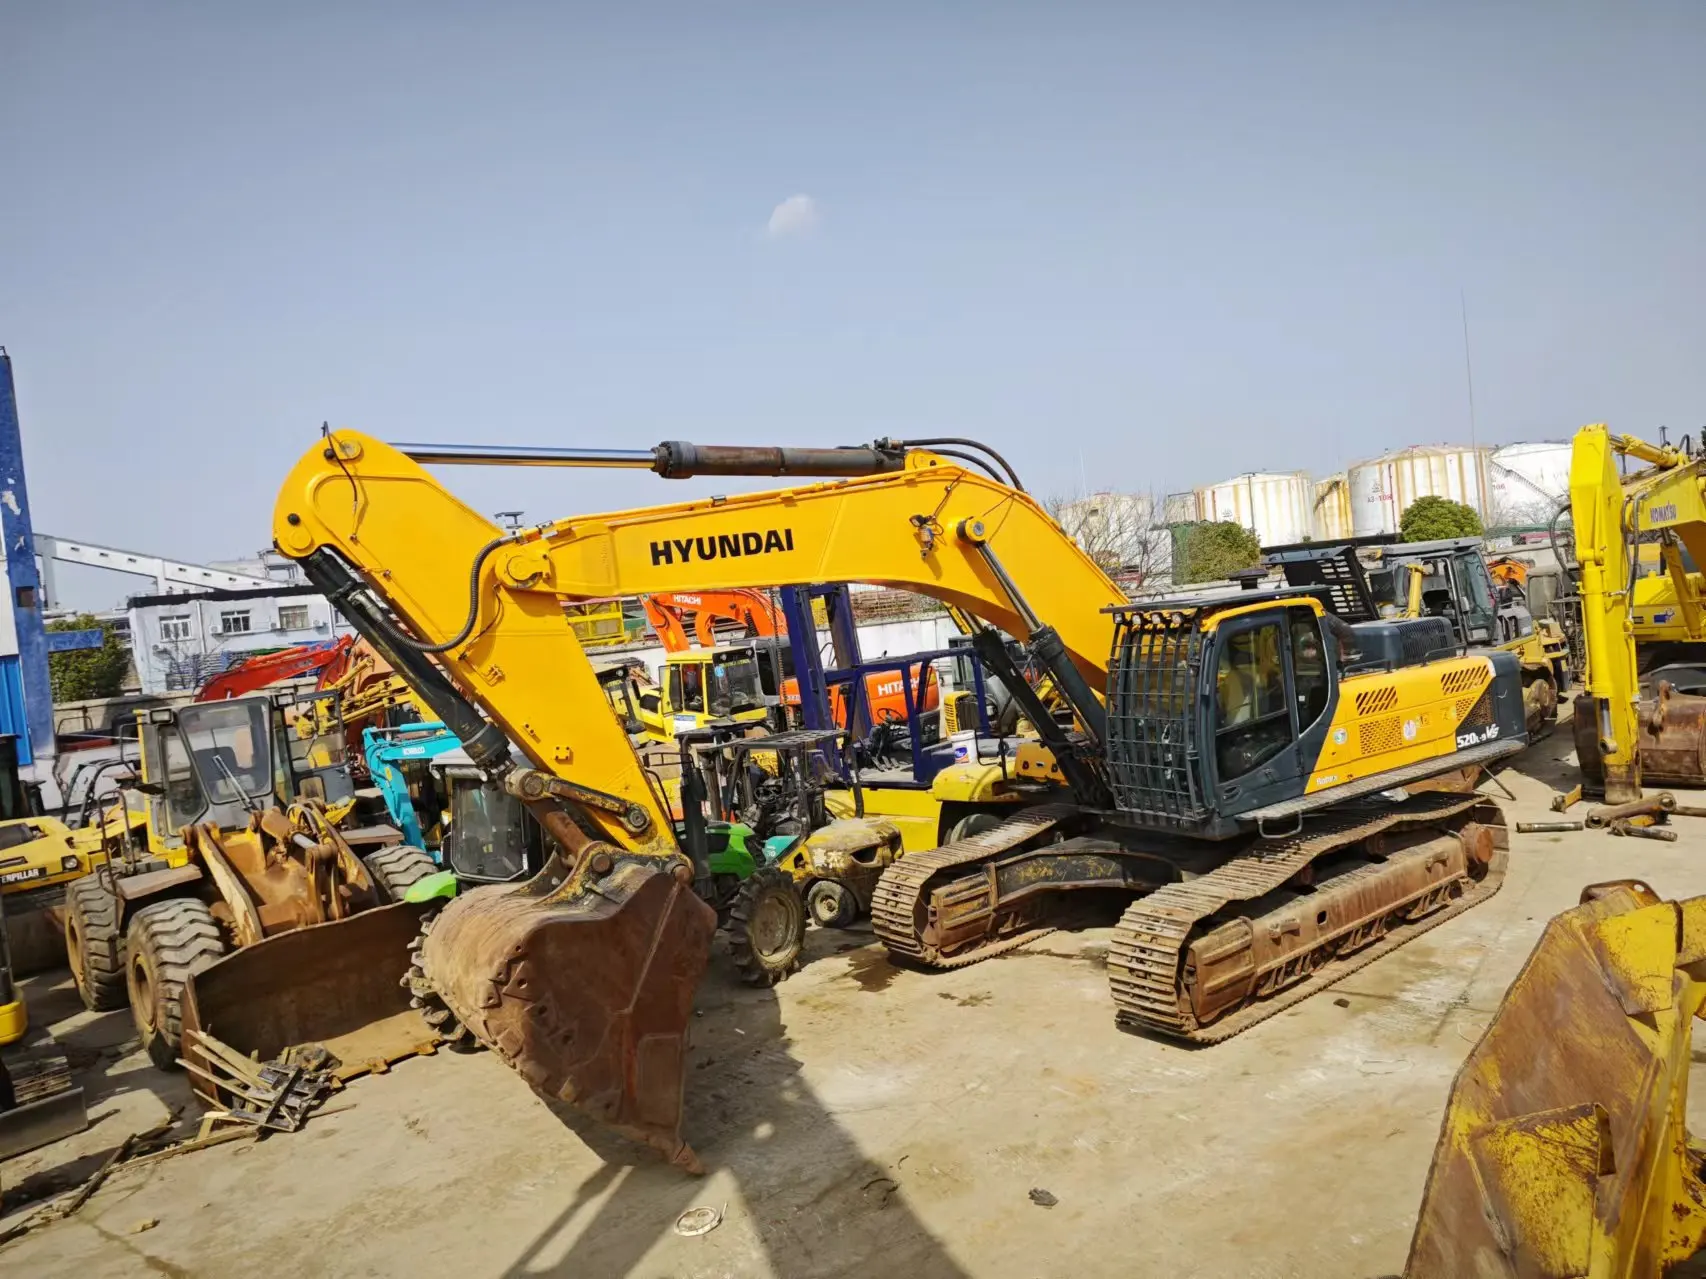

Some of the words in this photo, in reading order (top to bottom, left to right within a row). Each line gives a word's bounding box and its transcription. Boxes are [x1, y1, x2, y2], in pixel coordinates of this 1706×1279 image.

[1649, 500, 1677, 523] KOMATSU
[649, 528, 794, 566] HYUNDAI
[673, 594, 702, 605] HITACHI
[877, 677, 920, 697] HITAH
